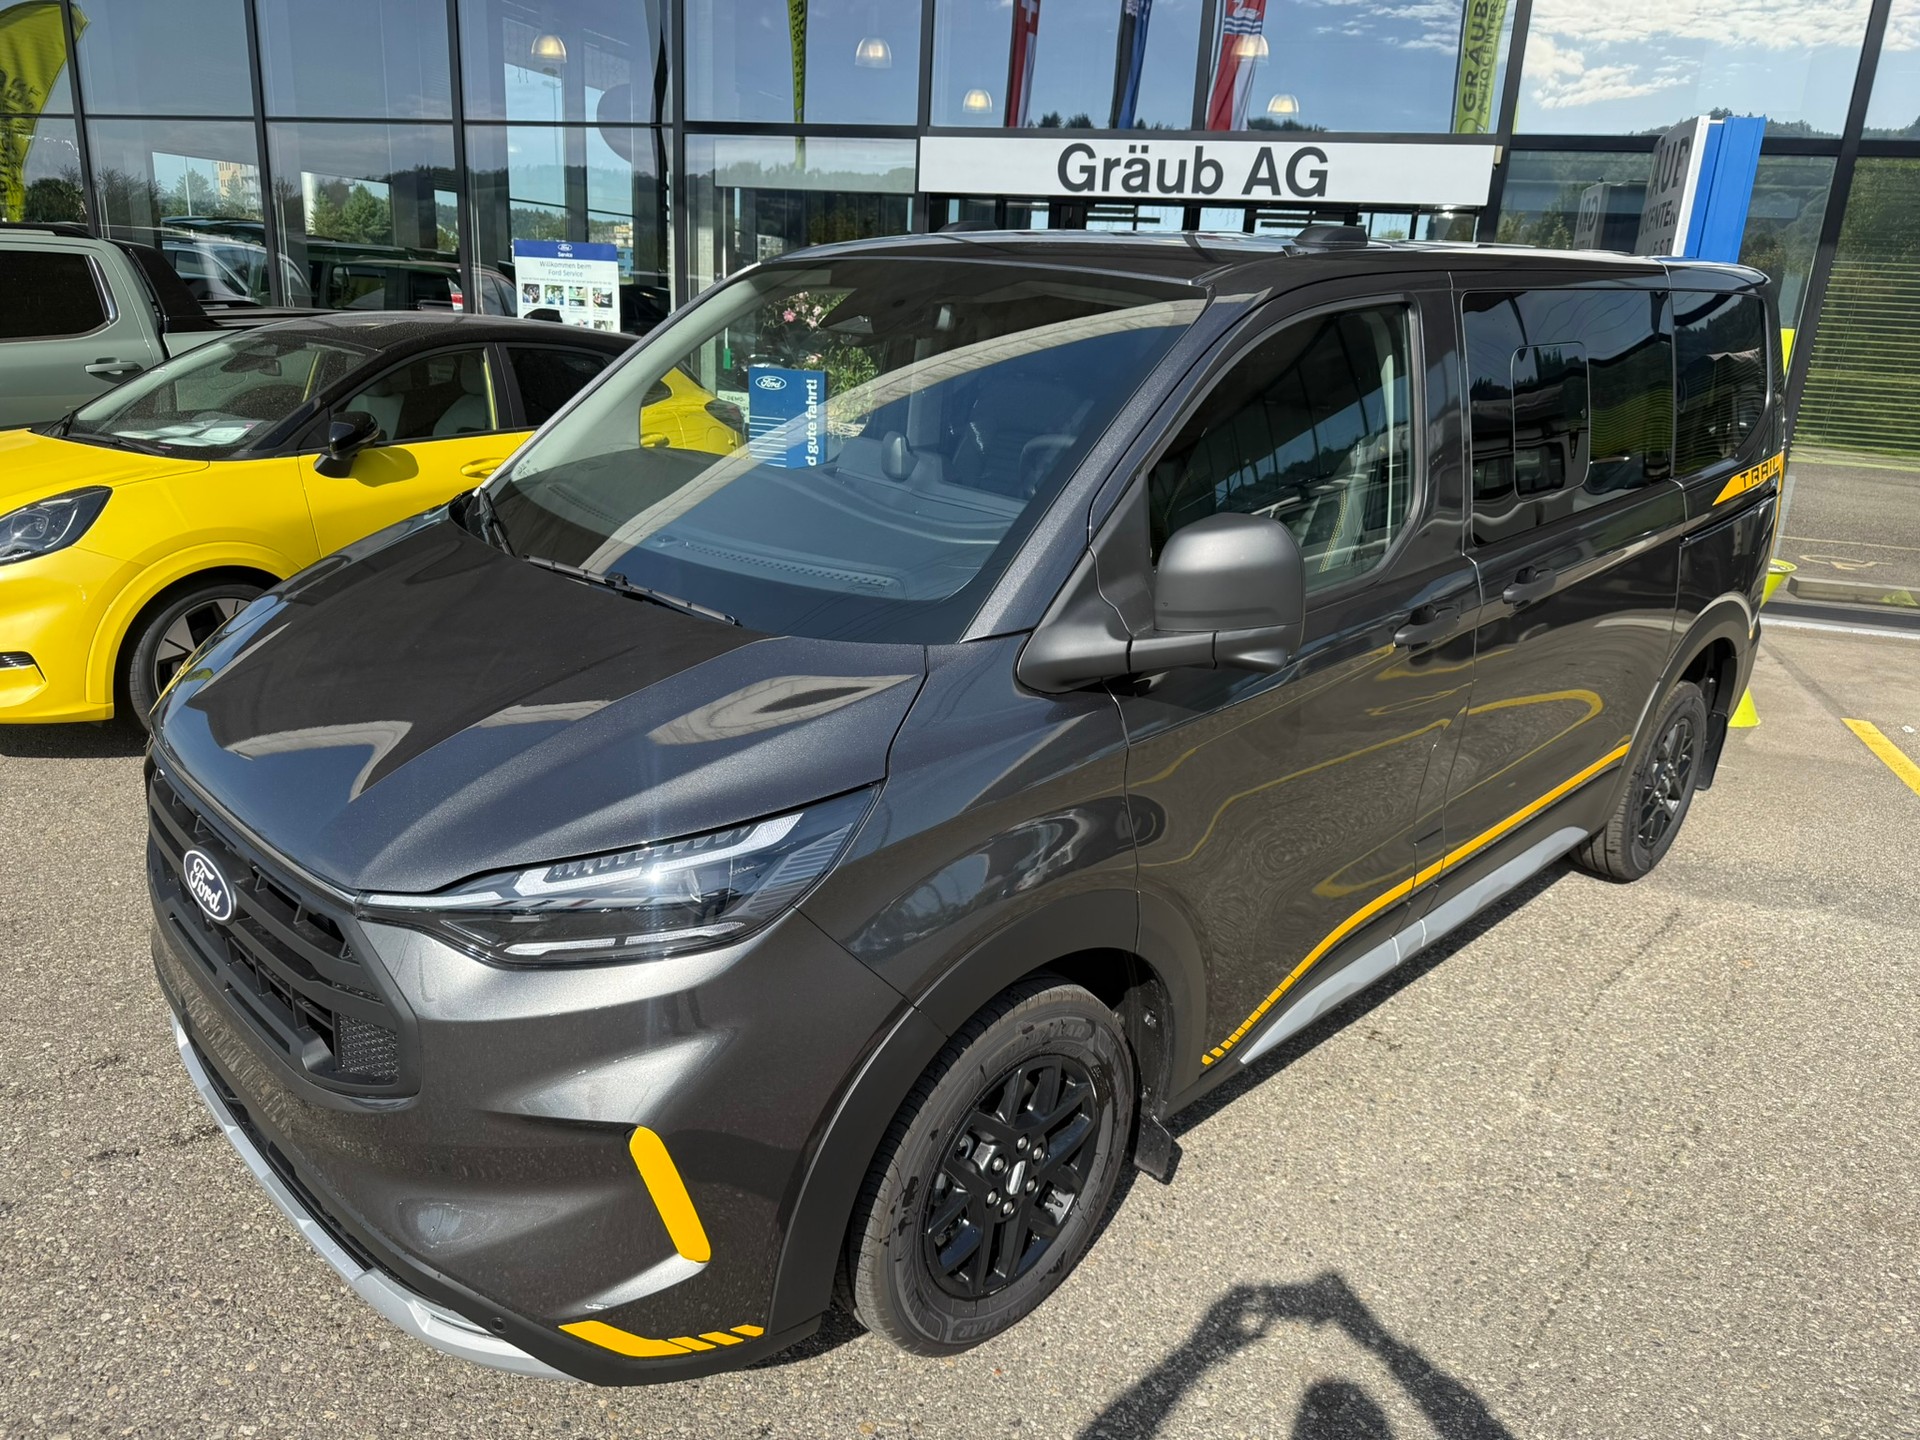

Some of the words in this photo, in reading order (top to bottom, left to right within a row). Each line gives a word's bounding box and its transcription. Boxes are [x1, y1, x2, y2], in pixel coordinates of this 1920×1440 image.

[1463, 1, 1489, 112] GRÄUB
[1057, 143, 1224, 195] Gräub
[1241, 146, 1329, 197] AG
[540, 261, 576, 269] Willkommen
[548, 269, 562, 277] Ford
[563, 270, 584, 278] Service
[760, 377, 782, 389] Ford
[805, 379, 818, 420] fahrt!
[806, 421, 819, 455] gute
[1740, 458, 1779, 489] TRAIL
[190, 858, 222, 912] Ford
